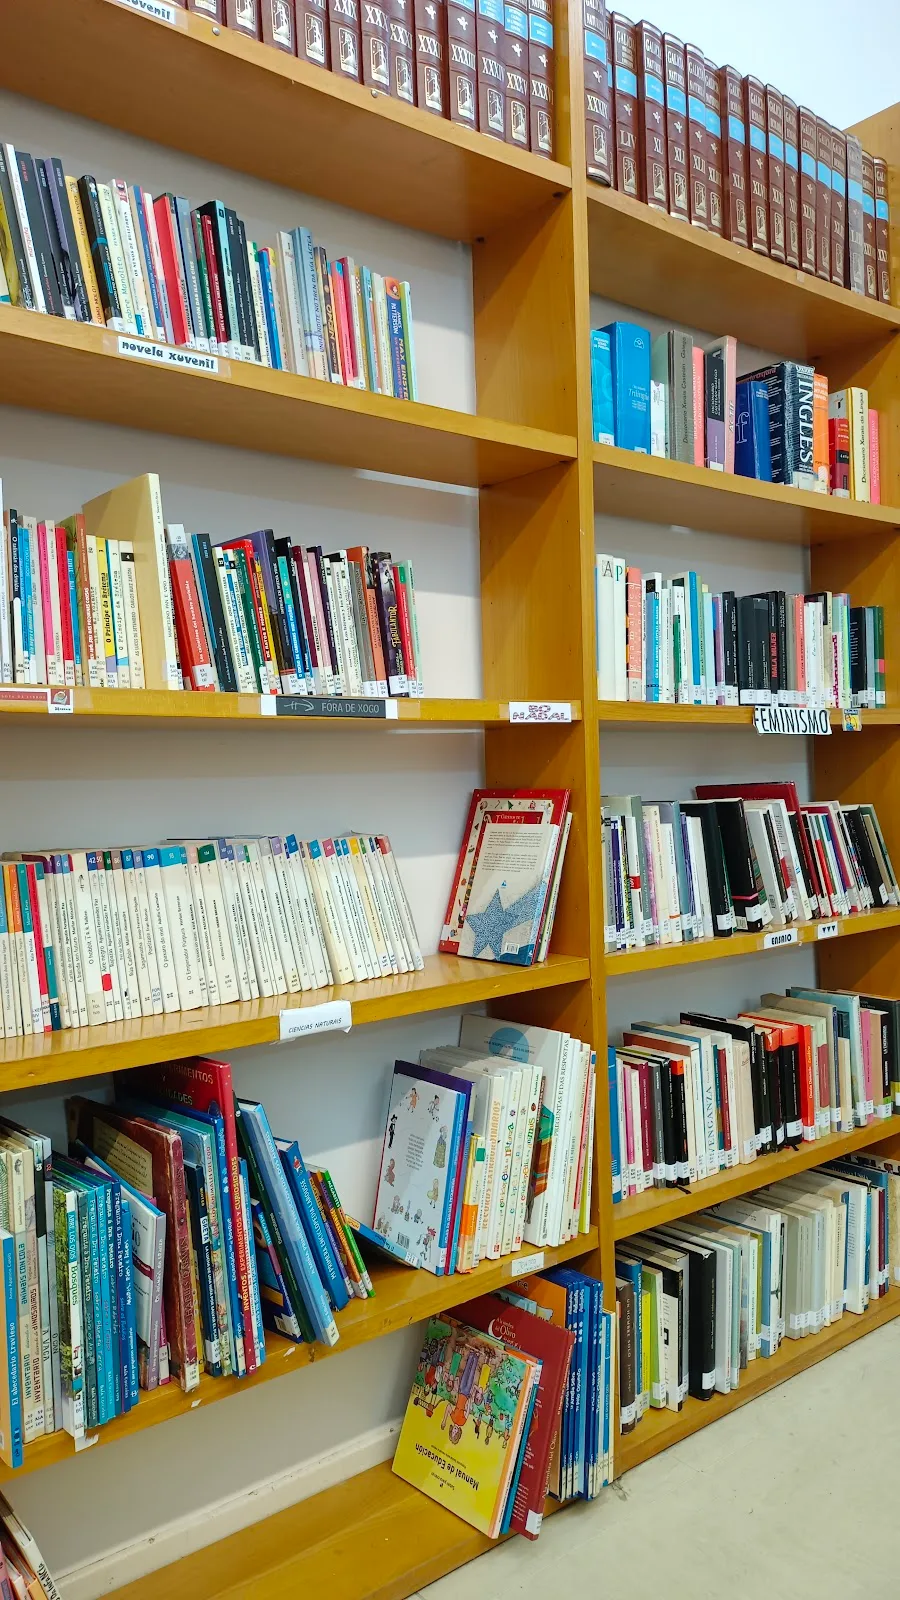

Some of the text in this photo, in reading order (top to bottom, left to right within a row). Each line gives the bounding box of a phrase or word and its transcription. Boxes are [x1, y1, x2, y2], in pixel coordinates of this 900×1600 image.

[365, 5, 388, 32] XXX
[120, 339, 215, 369] novela xuvenil
[99, 572, 107, 598] Brétema
[102, 600, 108, 608] da
[322, 700, 380, 714] FÓRA DE XOGO
[754, 708, 828, 734] FEMINISMO
[772, 933, 792, 945] ENSAIO
[288, 1018, 342, 1034] CIENCIAS NATURAIS
[552, 1095, 564, 1136] PREGUNTAS
[559, 1039, 570, 1075] RESPOSTAS
[704, 1086, 714, 1154] VENGANZA
[230, 1156, 241, 1210] CURIOSIDADES
[96, 1195, 104, 1226] Pregunta
[80, 1216, 89, 1248] Pregunta
[298, 1178, 338, 1279] MI PRIMERA ENCICLOPEDIA LAROUSSE
[235, 1217, 246, 1270] EXPERIMENTOS
[99, 1253, 107, 1279] Peteiro
[69, 1264, 79, 1305] Bosques
[83, 1274, 92, 1301] Peteiro
[240, 1272, 250, 1310] INVENTOS,
[7, 1322, 16, 1353] travieso
[500, 1324, 516, 1340] Olivo
[41, 1339, 50, 1361] VACA
[51, 1339, 59, 1354] CAN
[9, 1355, 18, 1395] abecedario
[549, 1429, 558, 1449] Olivo
[412, 1442, 481, 1490] Manual de Educación
